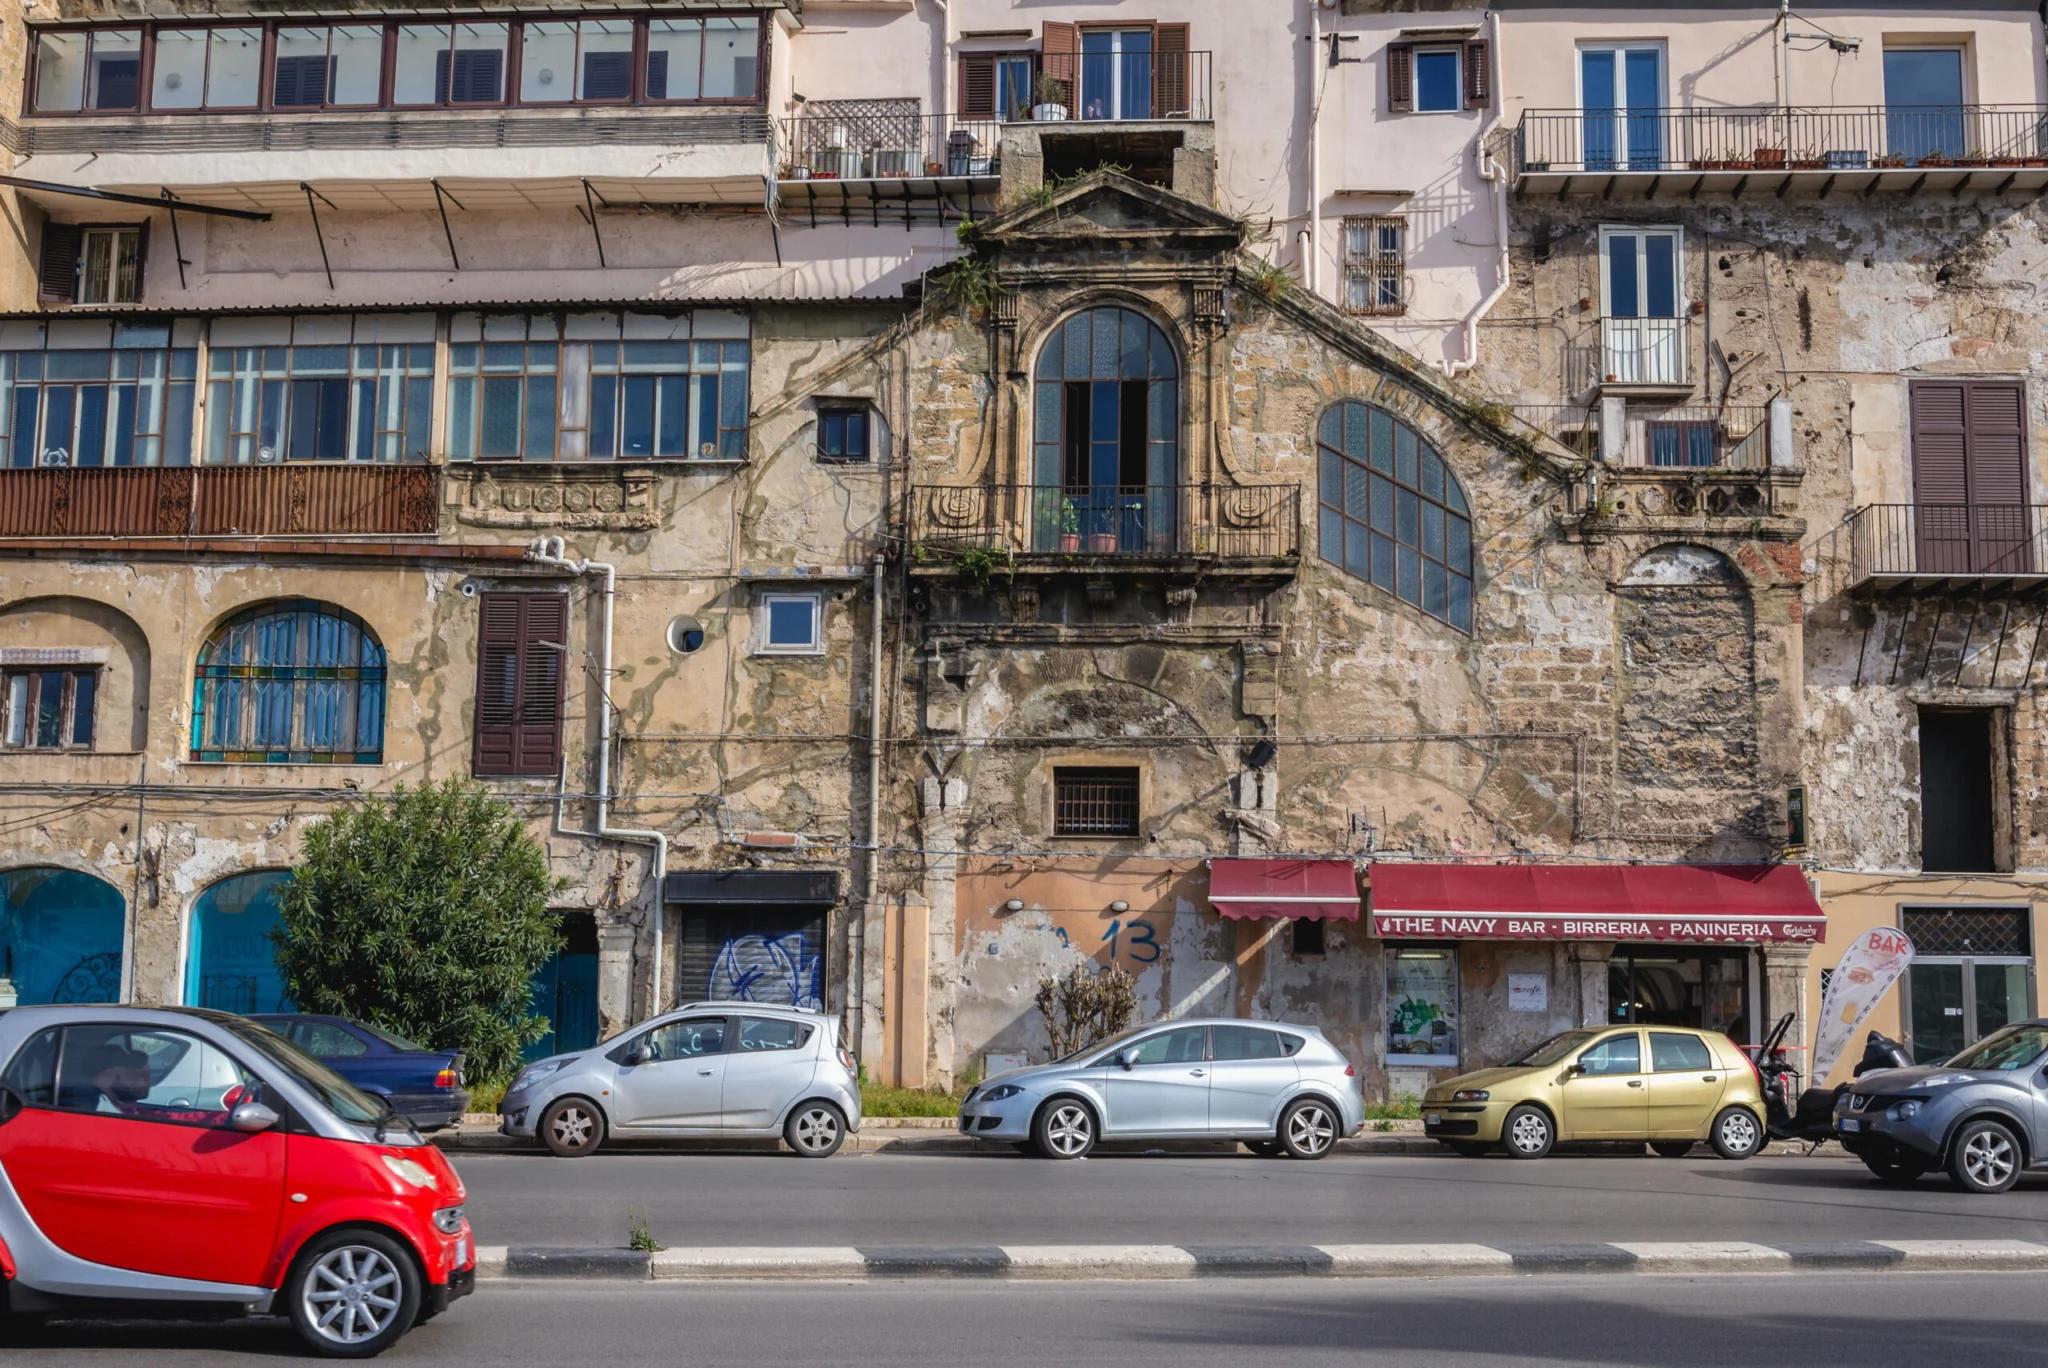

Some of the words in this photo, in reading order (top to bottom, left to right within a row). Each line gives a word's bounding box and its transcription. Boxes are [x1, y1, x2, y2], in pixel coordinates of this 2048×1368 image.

[1101, 919, 1162, 962] 13
[1391, 918, 1435, 932] THE
[1441, 918, 1498, 933] NAVY
[1508, 921, 1546, 933] BAR
[1563, 921, 1652, 935] BIRRERIA
[1670, 923, 1773, 936] PANINERIA
[1782, 924, 1817, 938] Carlsberg
[1868, 932, 1909, 955] BAR
[1820, 945, 1858, 1040] PANINERIA
[1830, 973, 1896, 1056] BIRRERIA
